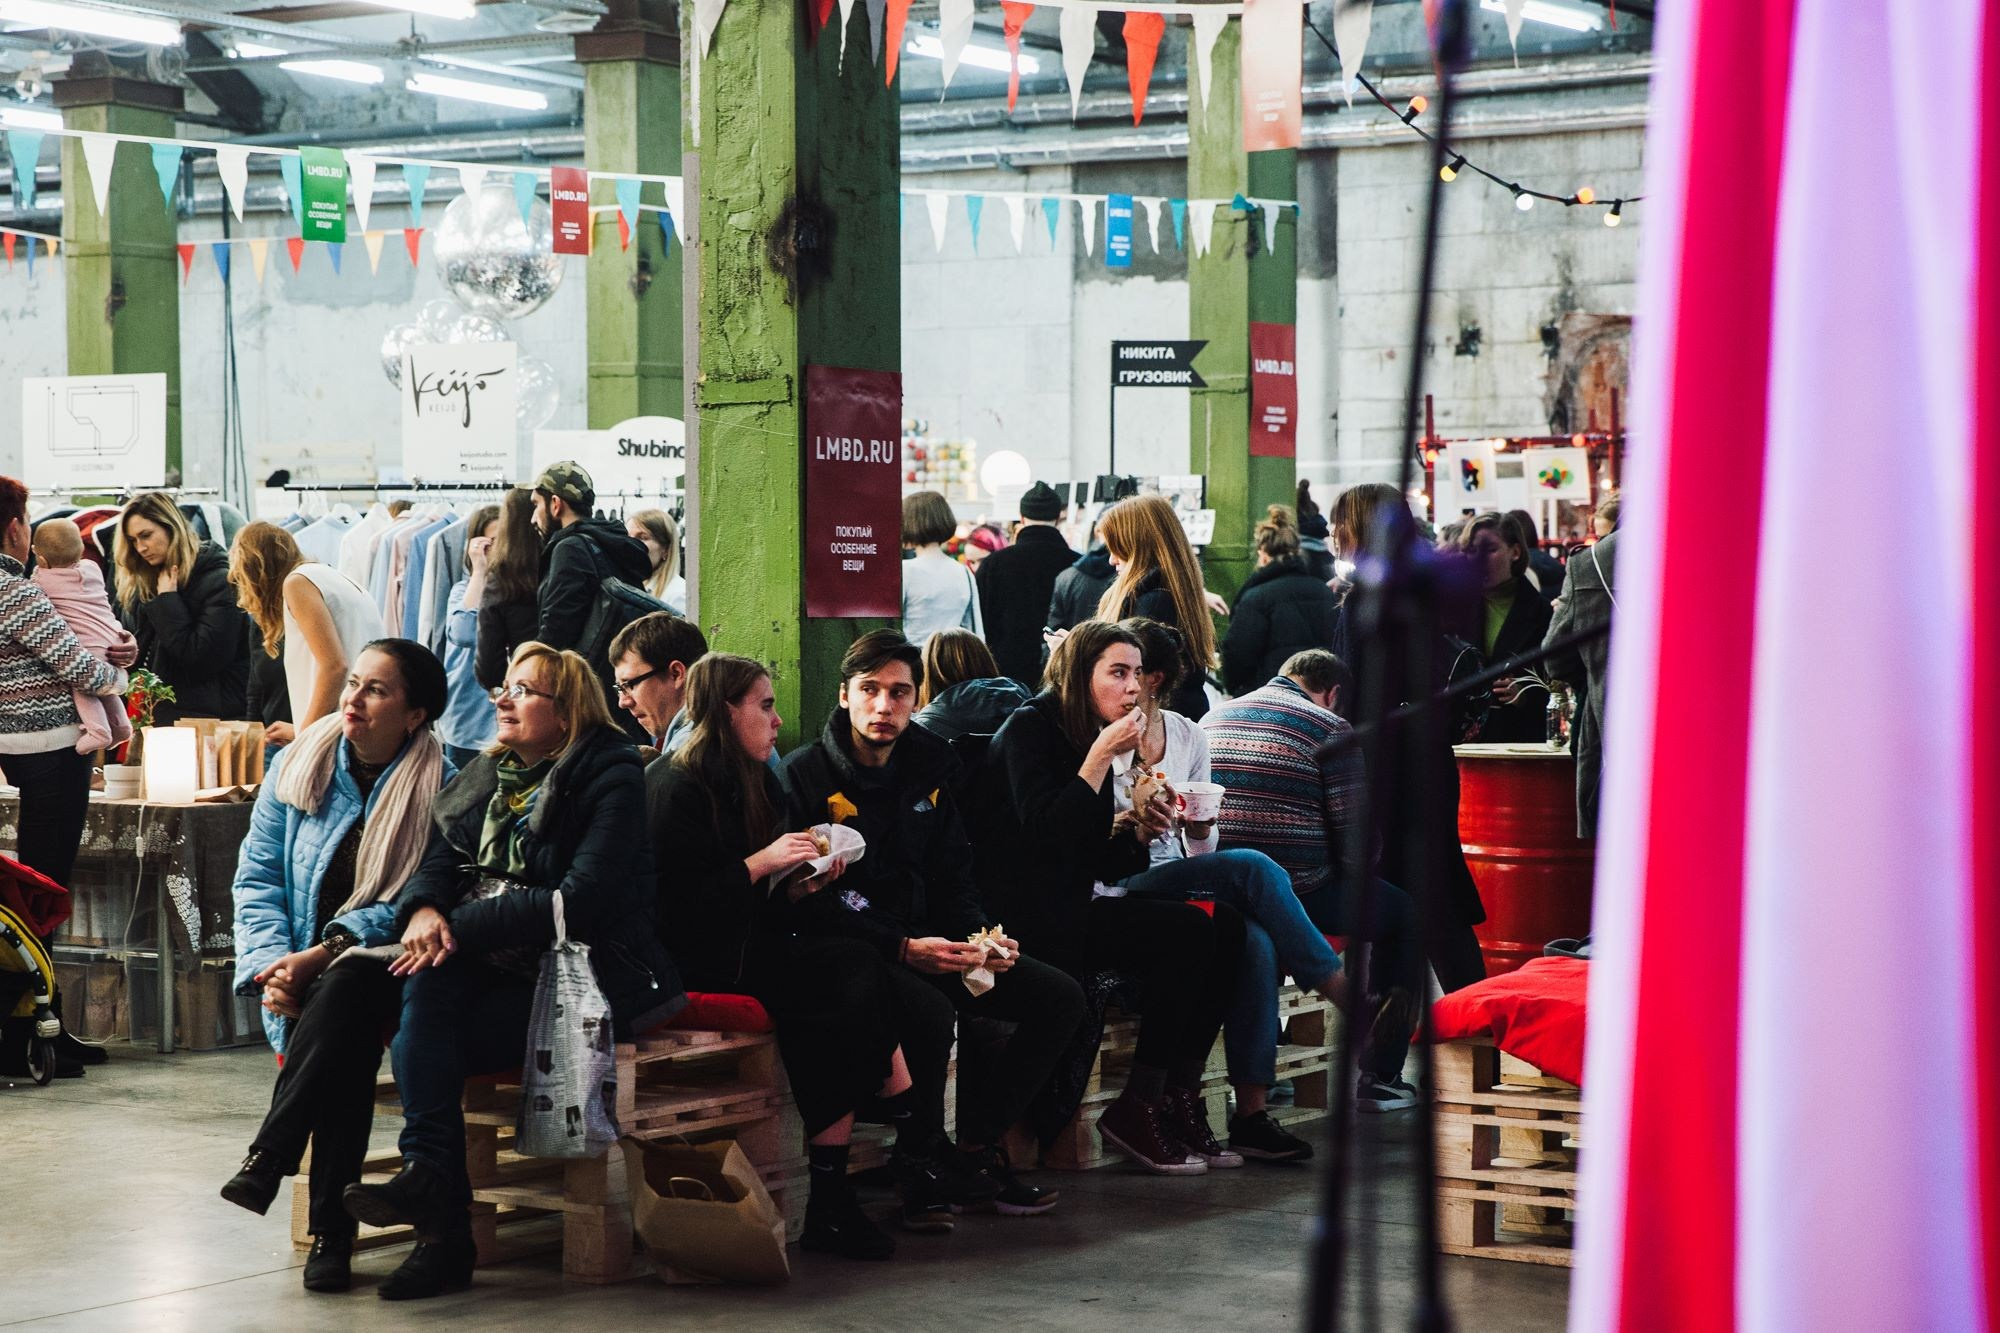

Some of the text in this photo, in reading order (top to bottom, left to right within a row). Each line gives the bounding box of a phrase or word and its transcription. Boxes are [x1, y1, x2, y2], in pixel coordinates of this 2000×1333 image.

[307, 165, 342, 178] LMBD.RU
[554, 189, 587, 202] LMBD.RU
[1119, 346, 1176, 360] НИКИТА
[1254, 358, 1294, 376] LMBD.RU
[1119, 370, 1192, 383] ГРУЗОВИК
[816, 436, 894, 464] LMBD.RU
[835, 525, 872, 538] ПОКУПАЙ
[830, 542, 877, 555] ОСОБЕННЫЕ
[842, 559, 865, 573] ВЕЩИ
